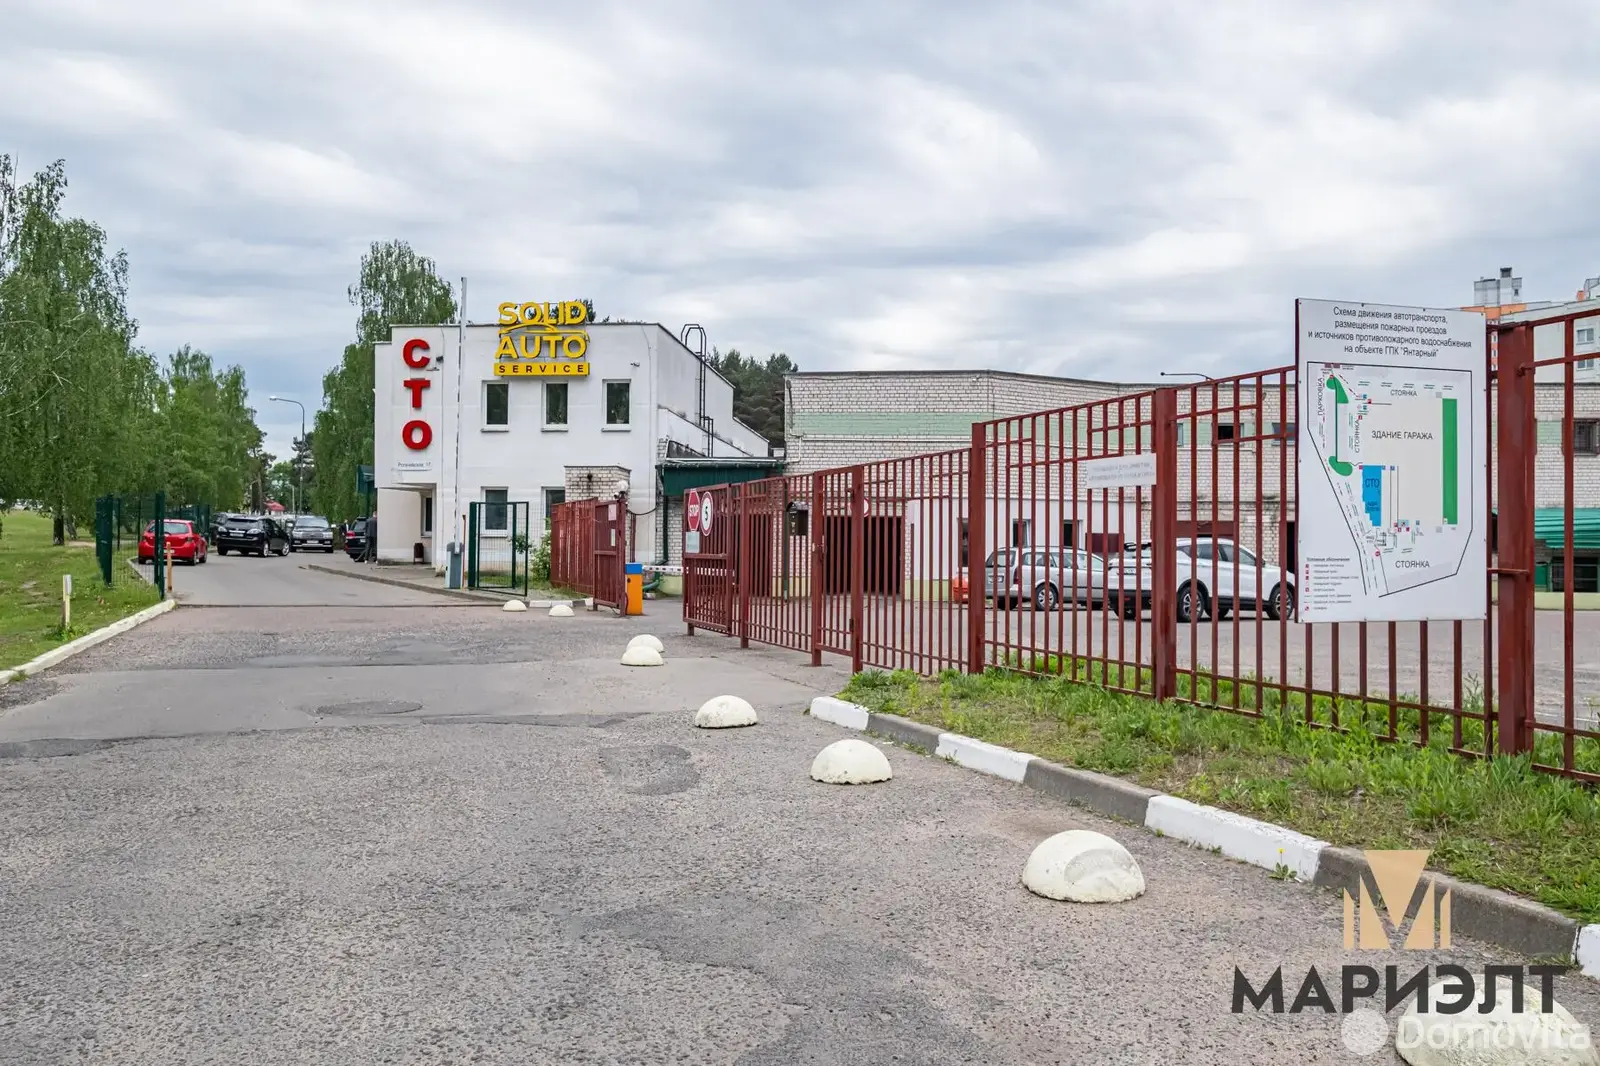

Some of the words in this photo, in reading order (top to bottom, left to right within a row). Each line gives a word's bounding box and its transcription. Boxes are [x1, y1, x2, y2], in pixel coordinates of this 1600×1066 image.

[498, 301, 587, 325] SOLID
[1333, 306, 1356, 317] Схема
[1358, 310, 1392, 319] движения
[1393, 312, 1448, 324] автотранспорта,
[1334, 320, 1379, 330] размещения
[1380, 323, 1414, 333] пожарных
[1416, 326, 1447, 335] проездов
[494, 335, 587, 359] AUTO
[1314, 331, 1354, 341] источников
[1355, 334, 1420, 345] противопожарного
[1421, 338, 1472, 348] водоснабжения
[1344, 345, 1353, 353] на
[1354, 345, 1384, 355] объекте
[1384, 345, 1399, 355] ГПК
[499, 365, 584, 373] SERVICE
[402, 338, 433, 450] СТО
[1390, 389, 1418, 397] СТОЯНКА
[1371, 430, 1402, 440] ЗДАНИЕ
[1403, 431, 1433, 440] ГАРАЖА
[1365, 478, 1380, 488] СТО
[704, 506, 709, 521] 5
[1395, 560, 1430, 569] СТОЯНКА
